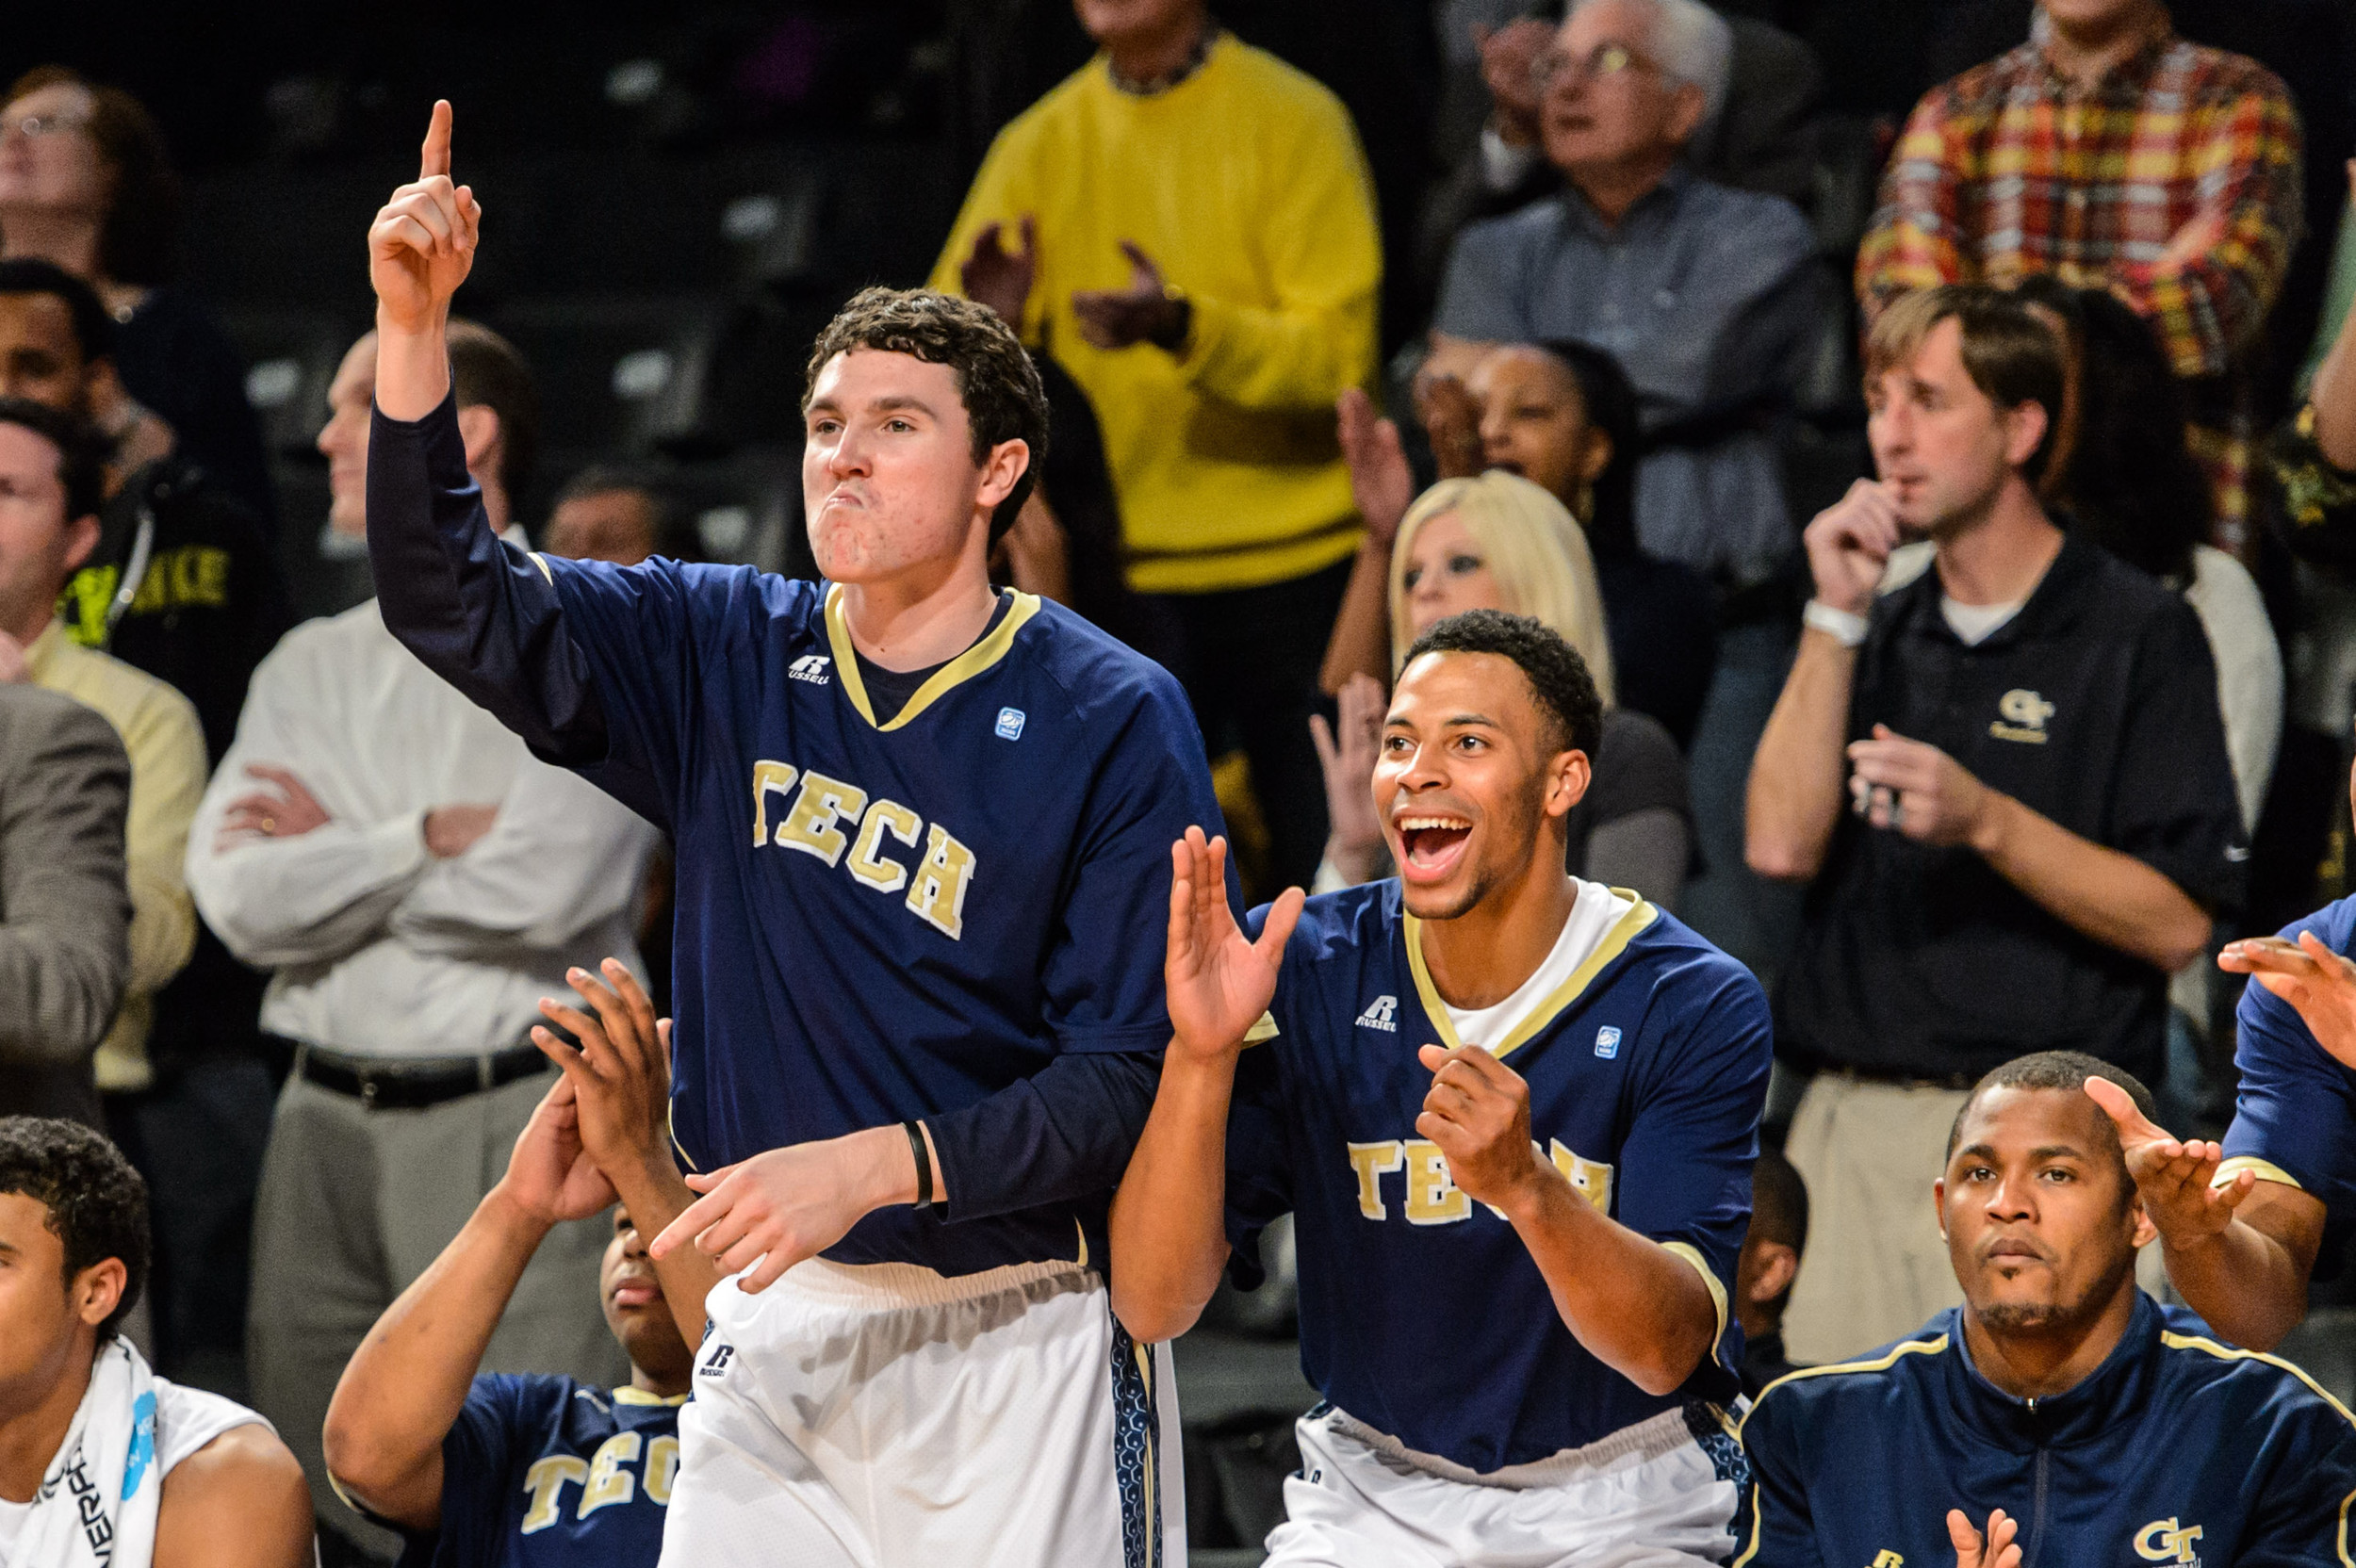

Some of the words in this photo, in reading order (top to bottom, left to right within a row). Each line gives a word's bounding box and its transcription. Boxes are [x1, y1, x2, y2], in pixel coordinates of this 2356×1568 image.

[788, 669, 829, 685] USSELL
[753, 760, 977, 941] TECH
[1354, 1015, 1397, 1033] RUSSEL
[1348, 1137, 1613, 1225] TEH
[521, 1430, 680, 1535] TEC
[2133, 1515, 2203, 1563] GT
